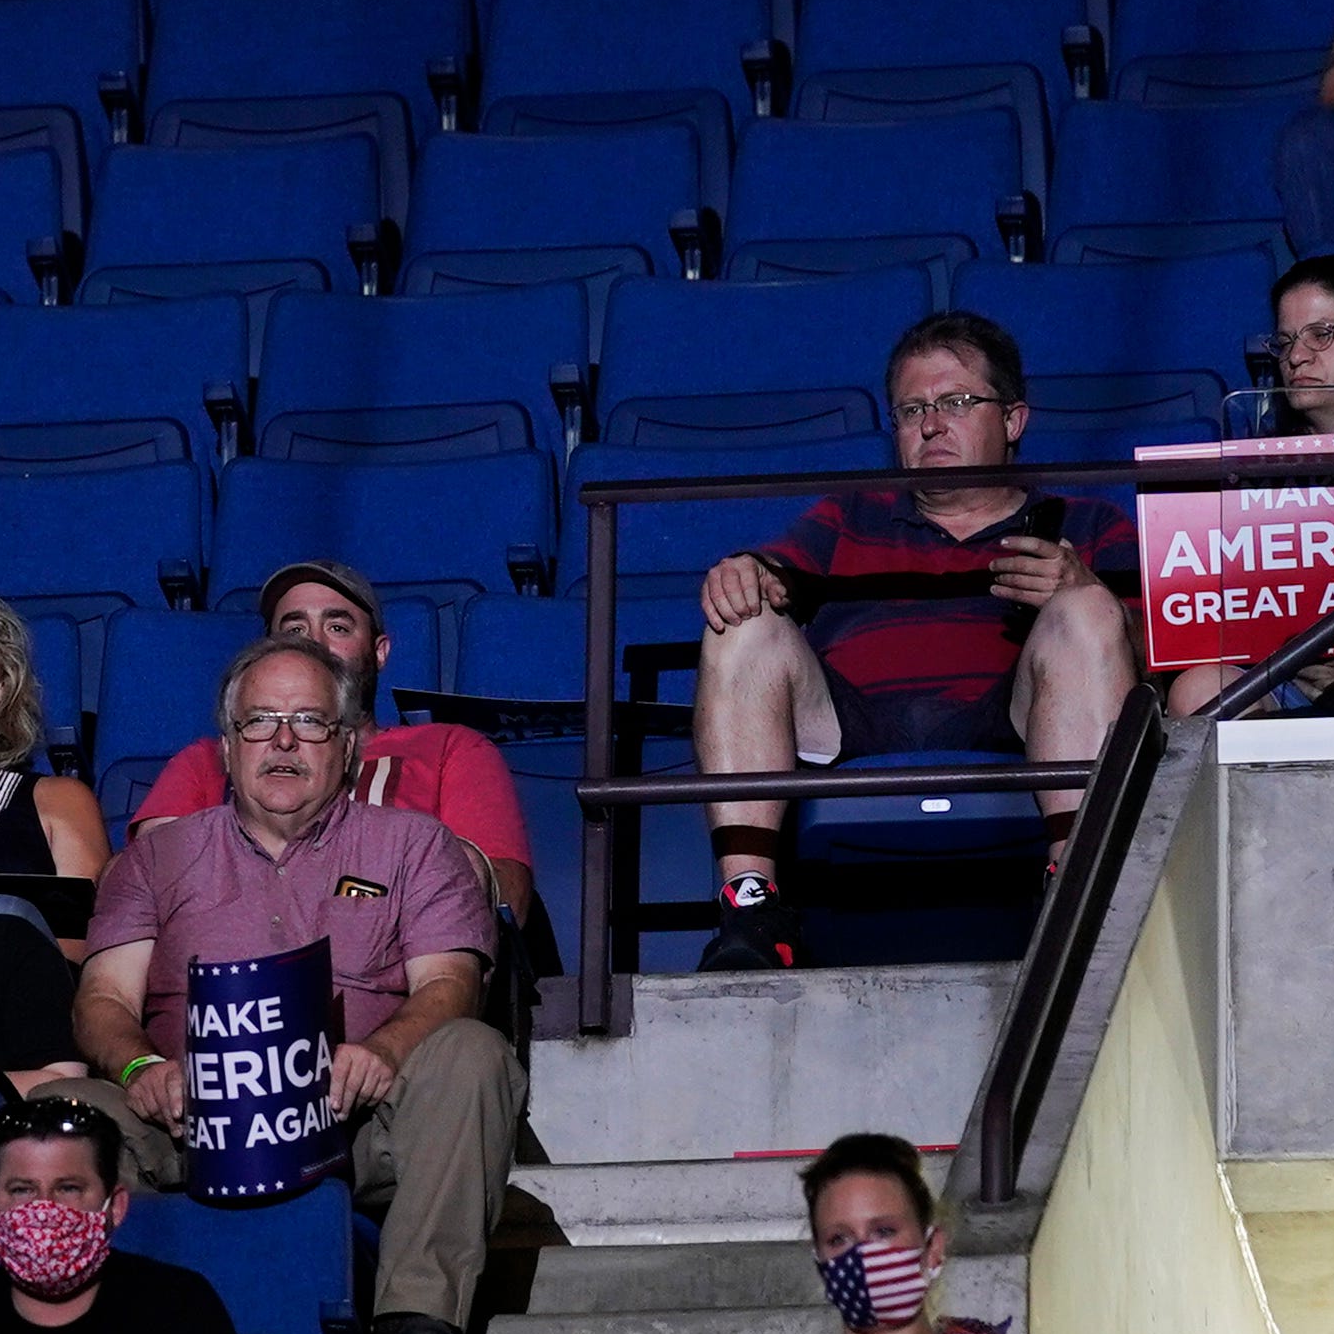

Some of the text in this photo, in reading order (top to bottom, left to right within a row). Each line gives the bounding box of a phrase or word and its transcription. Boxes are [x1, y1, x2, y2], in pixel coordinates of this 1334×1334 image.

[1162, 584, 1305, 626] GREAT
[187, 1030, 333, 1101] ERICA
[187, 1116, 232, 1151] EAT
